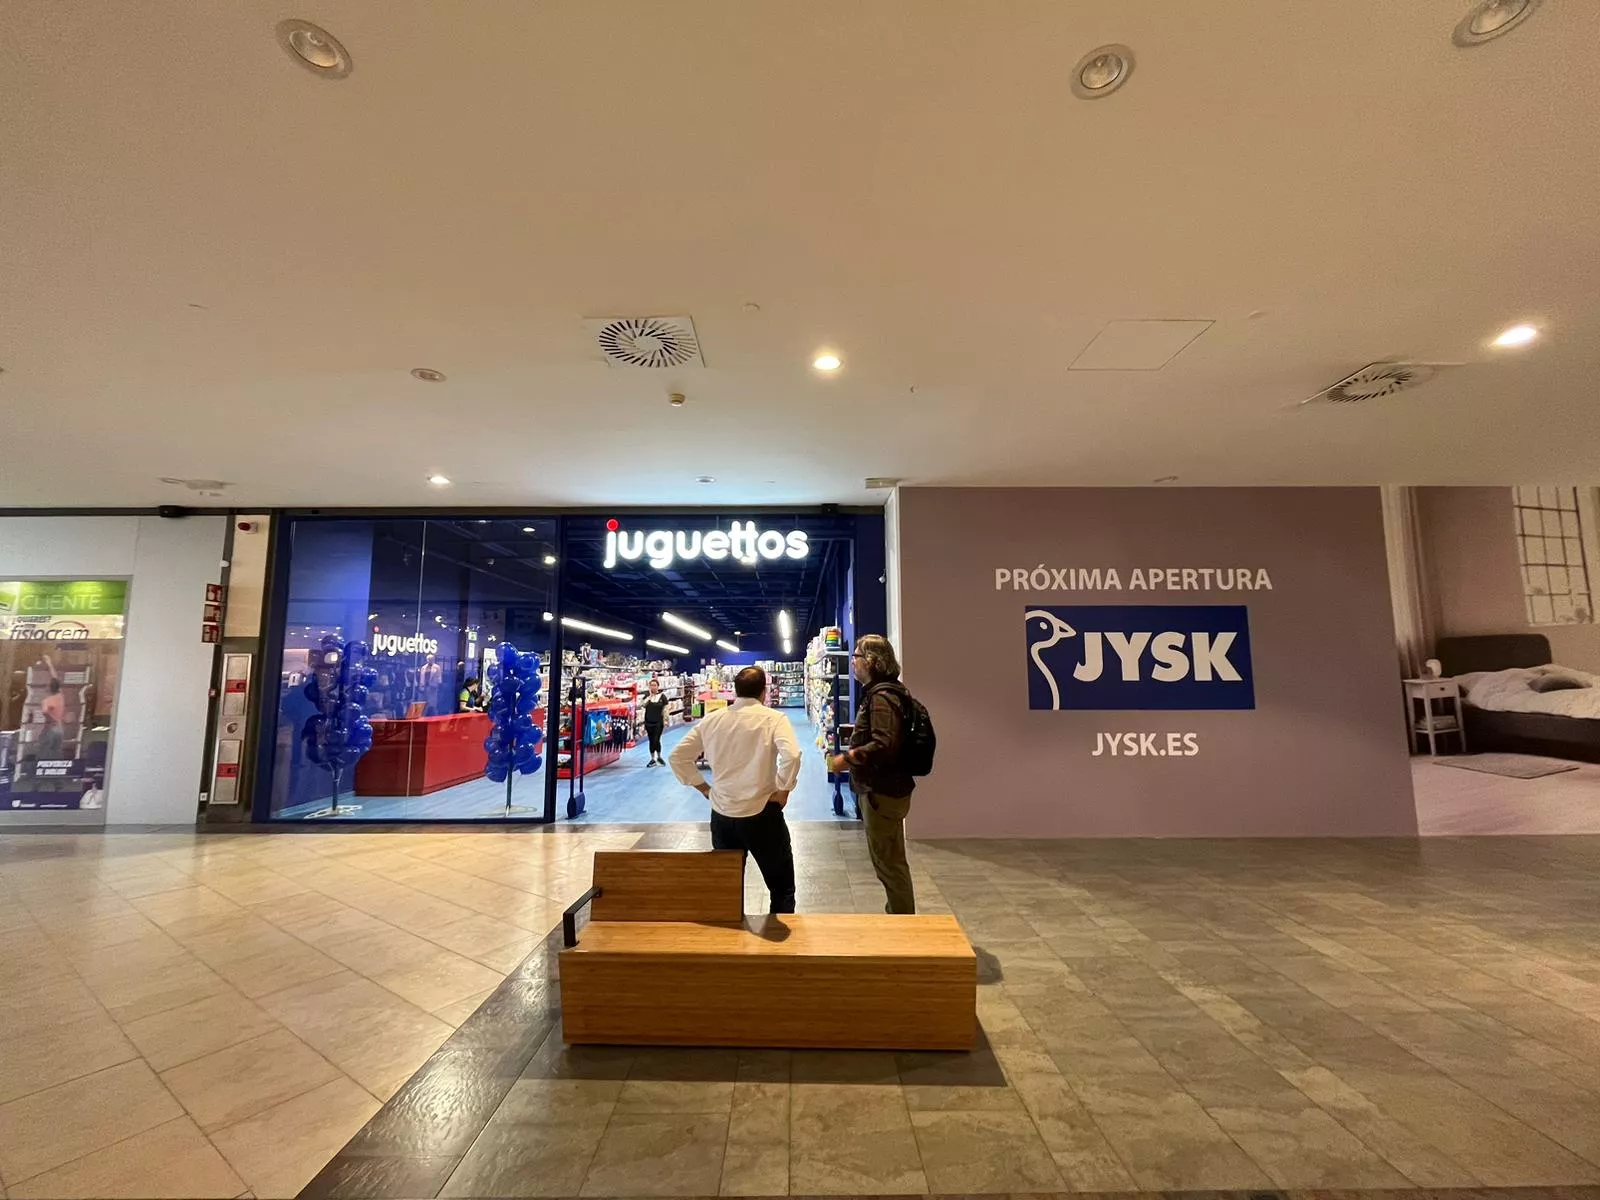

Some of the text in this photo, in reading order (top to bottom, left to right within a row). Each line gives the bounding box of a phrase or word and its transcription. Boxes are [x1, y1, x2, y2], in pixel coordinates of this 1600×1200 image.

[603, 518, 810, 569] juguettos
[994, 564, 1273, 590] PRÓXIMA APERTURA
[21, 594, 102, 610] CLIENTE
[10, 623, 89, 640] fisiocrem
[371, 625, 438, 656] juguettos
[1072, 631, 1243, 682] JYSK
[1091, 732, 1200, 756] JYSK.ES
